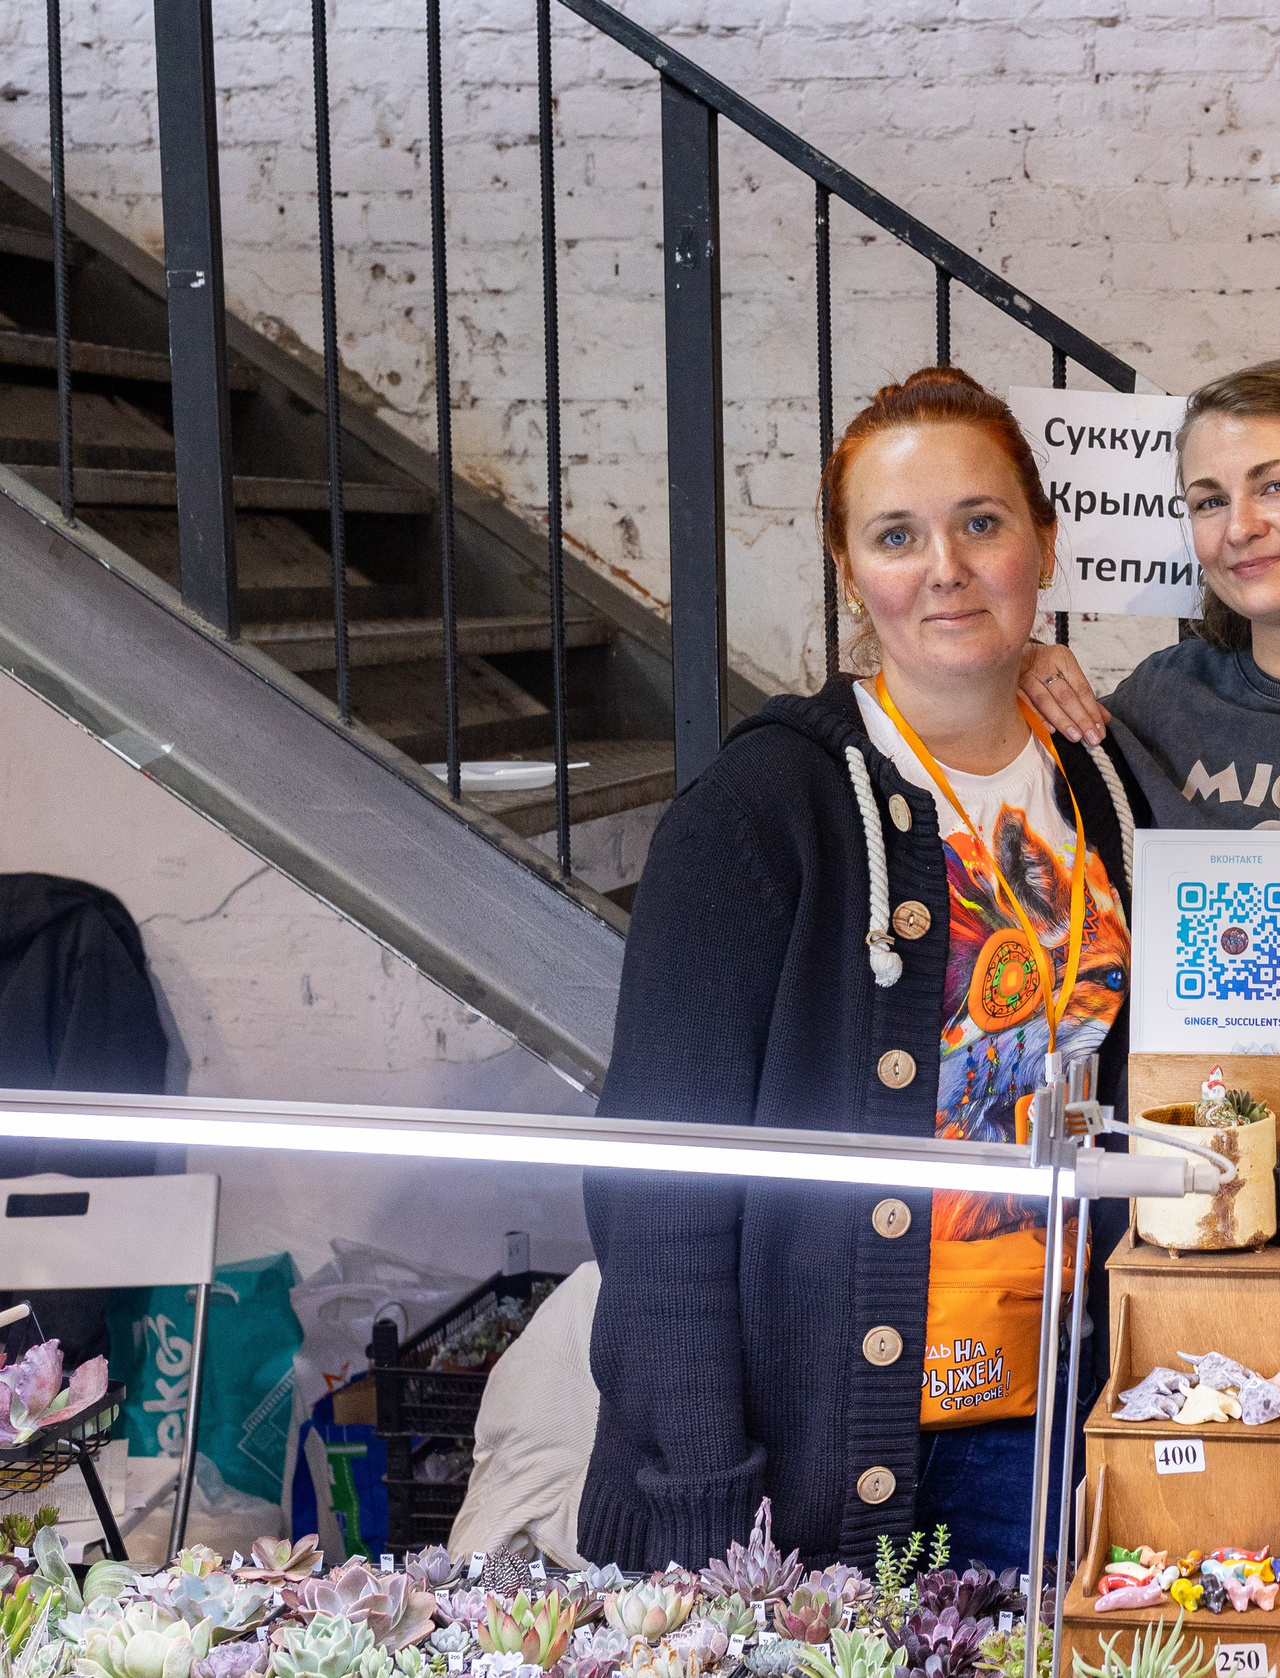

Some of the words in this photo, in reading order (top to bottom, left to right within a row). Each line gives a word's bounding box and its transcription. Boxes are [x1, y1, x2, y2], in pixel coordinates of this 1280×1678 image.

[1044, 417, 1173, 459] Суккул
[1049, 481, 1190, 522] Крымс
[1076, 557, 1203, 587] тепли
[1210, 854, 1263, 864] ВКОНТАКТЕ
[1158, 1445, 1198, 1466] 400
[1217, 1650, 1260, 1672] 250
